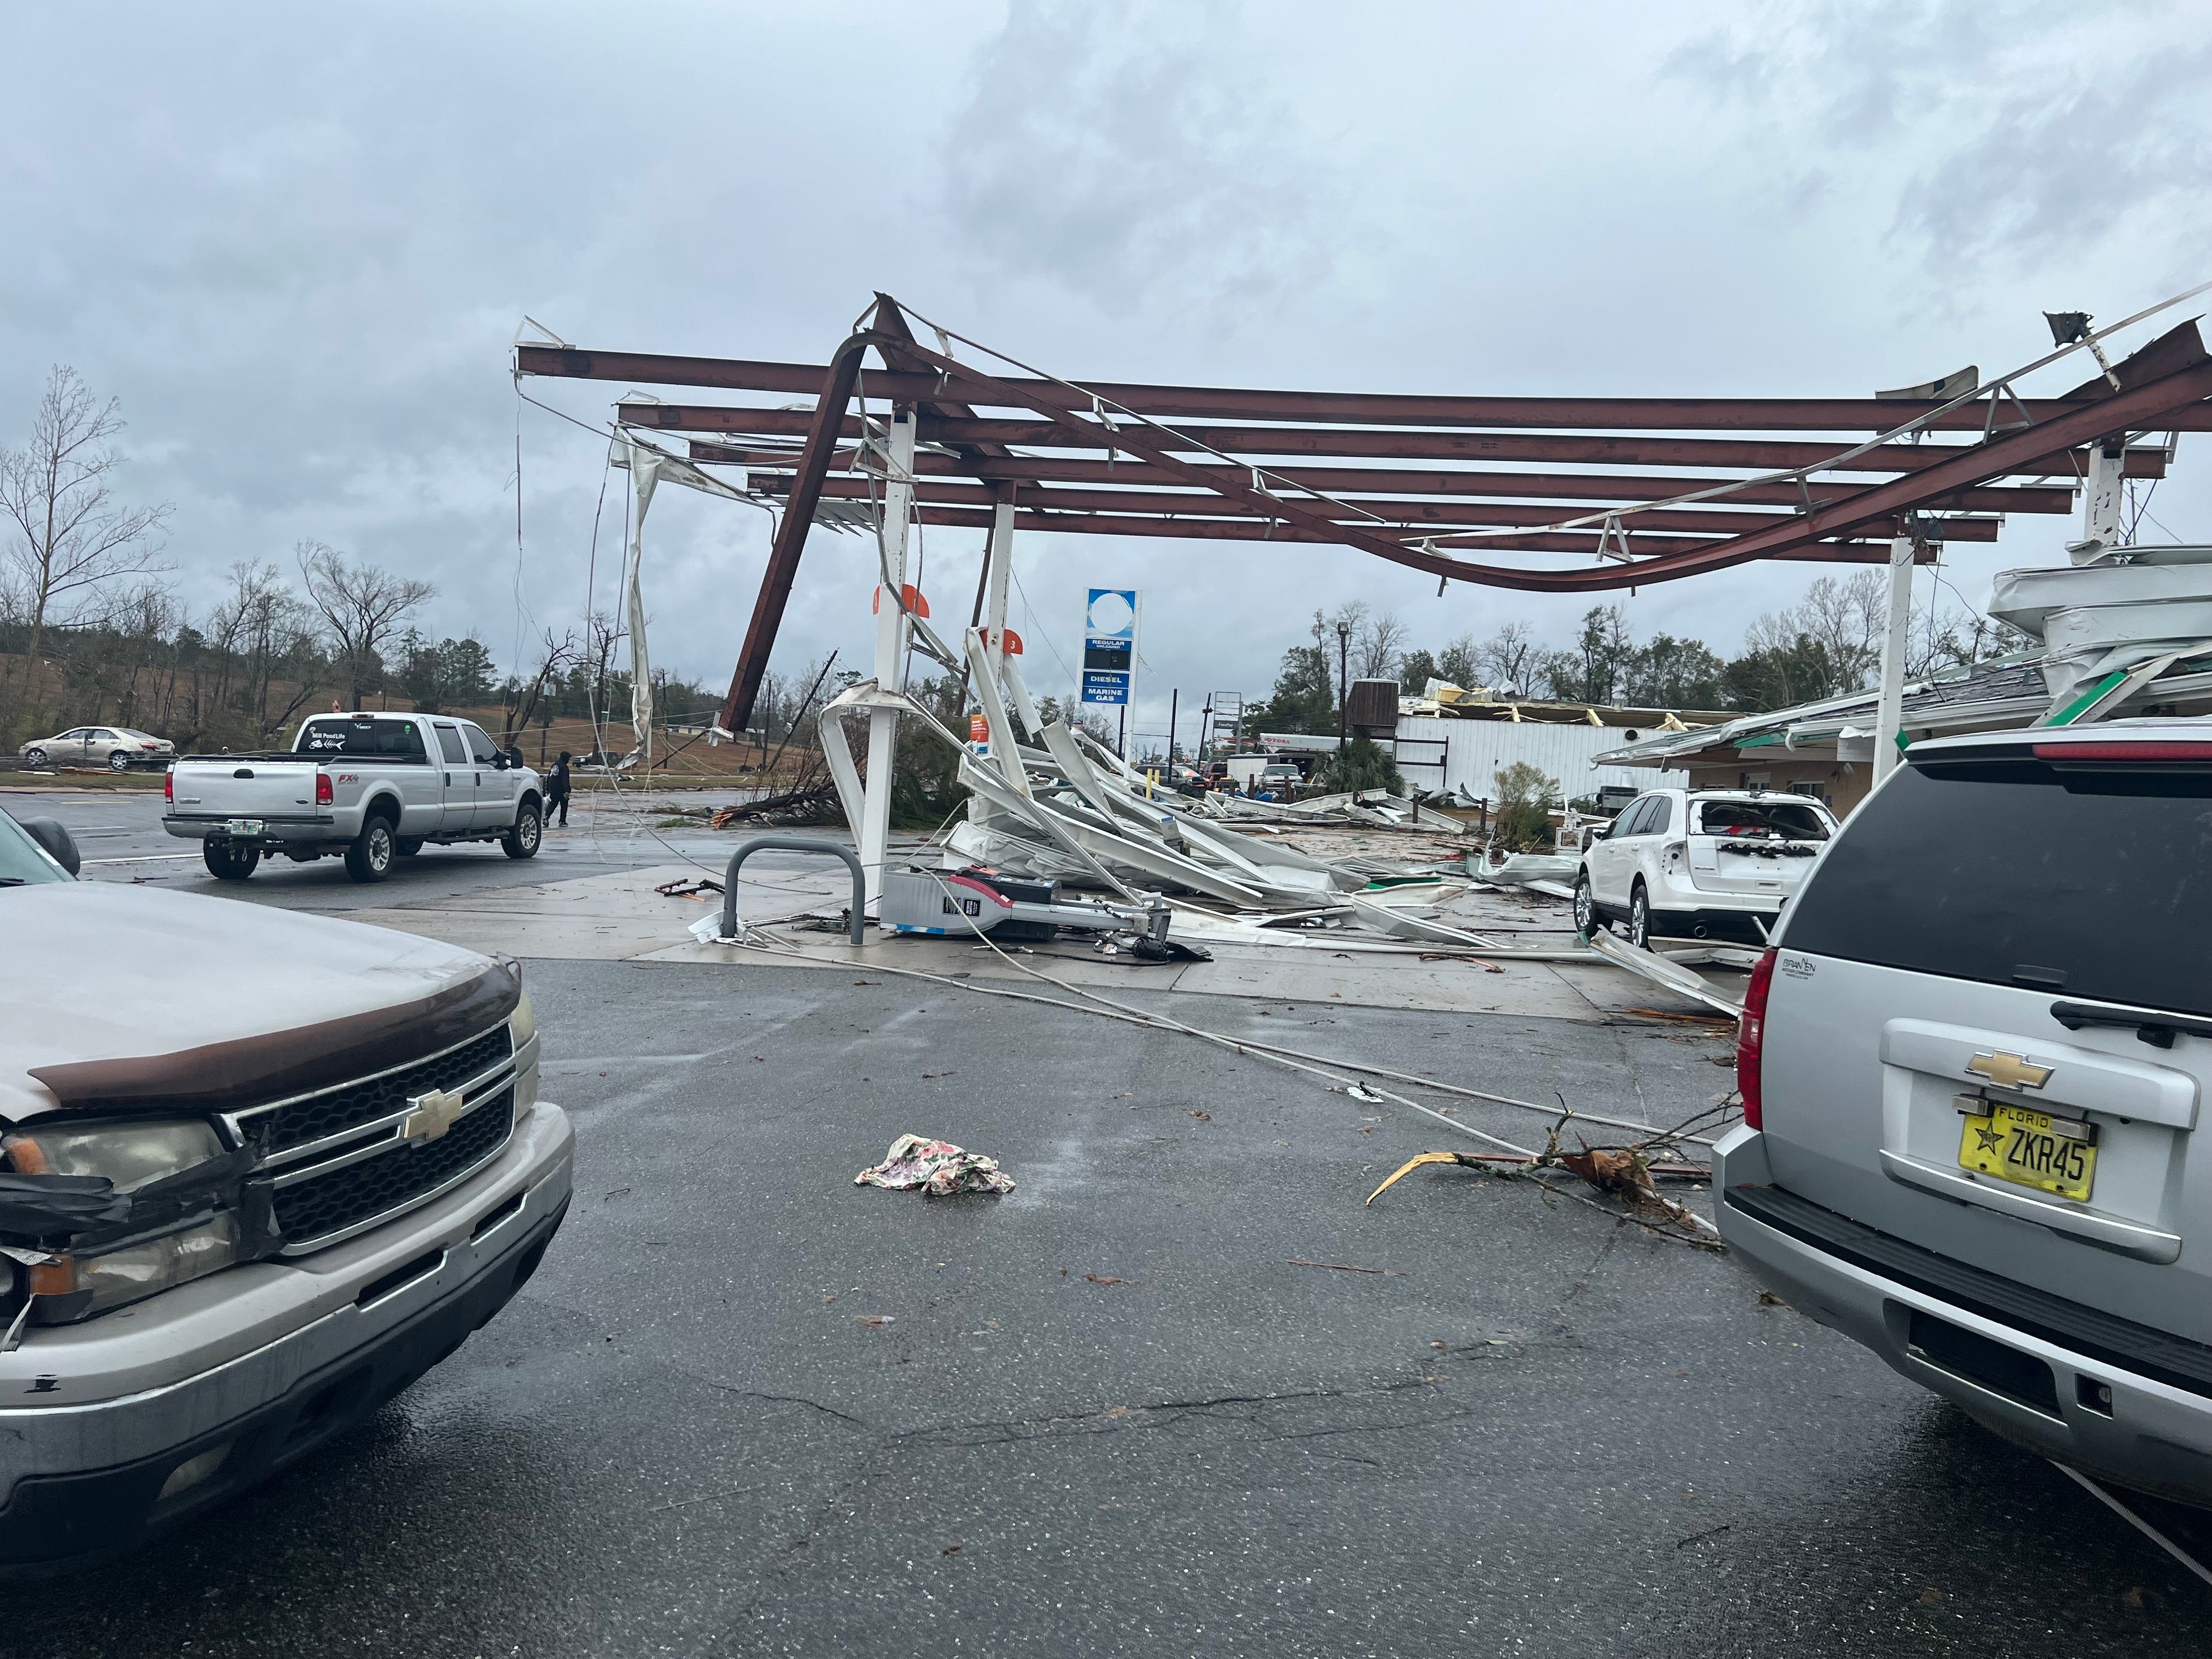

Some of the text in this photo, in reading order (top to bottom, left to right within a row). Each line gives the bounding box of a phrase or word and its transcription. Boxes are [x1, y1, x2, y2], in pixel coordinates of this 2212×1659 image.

[1011, 640, 1016, 650] 3
[1090, 675, 1122, 684] DIESEL
[1999, 1107, 2049, 1128] FLORID
[2008, 1127, 2087, 1181] ZKR45
